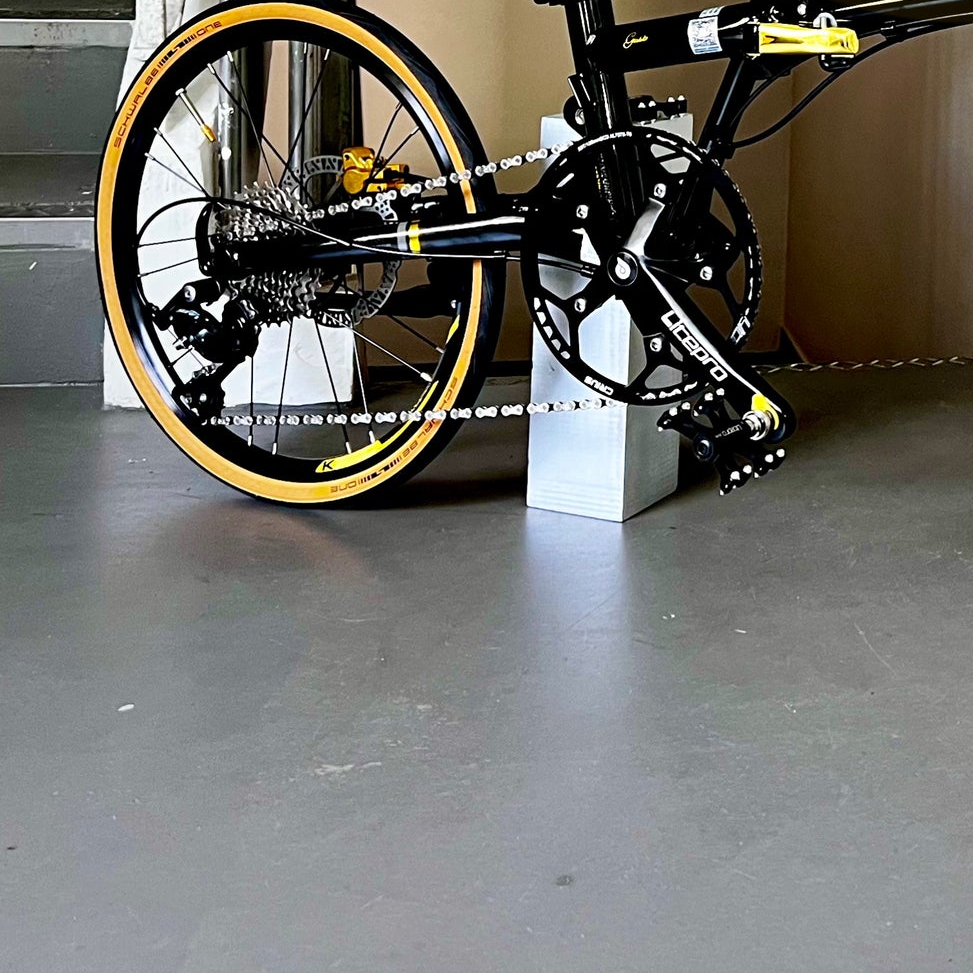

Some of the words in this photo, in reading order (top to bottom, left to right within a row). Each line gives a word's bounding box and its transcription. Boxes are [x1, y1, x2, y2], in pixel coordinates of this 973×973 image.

[113, 67, 159, 148] SCHWALBE
[196, 20, 223, 38] ONE
[402, 377, 458, 458] SCHALBE
[330, 480, 357, 494] ONE
